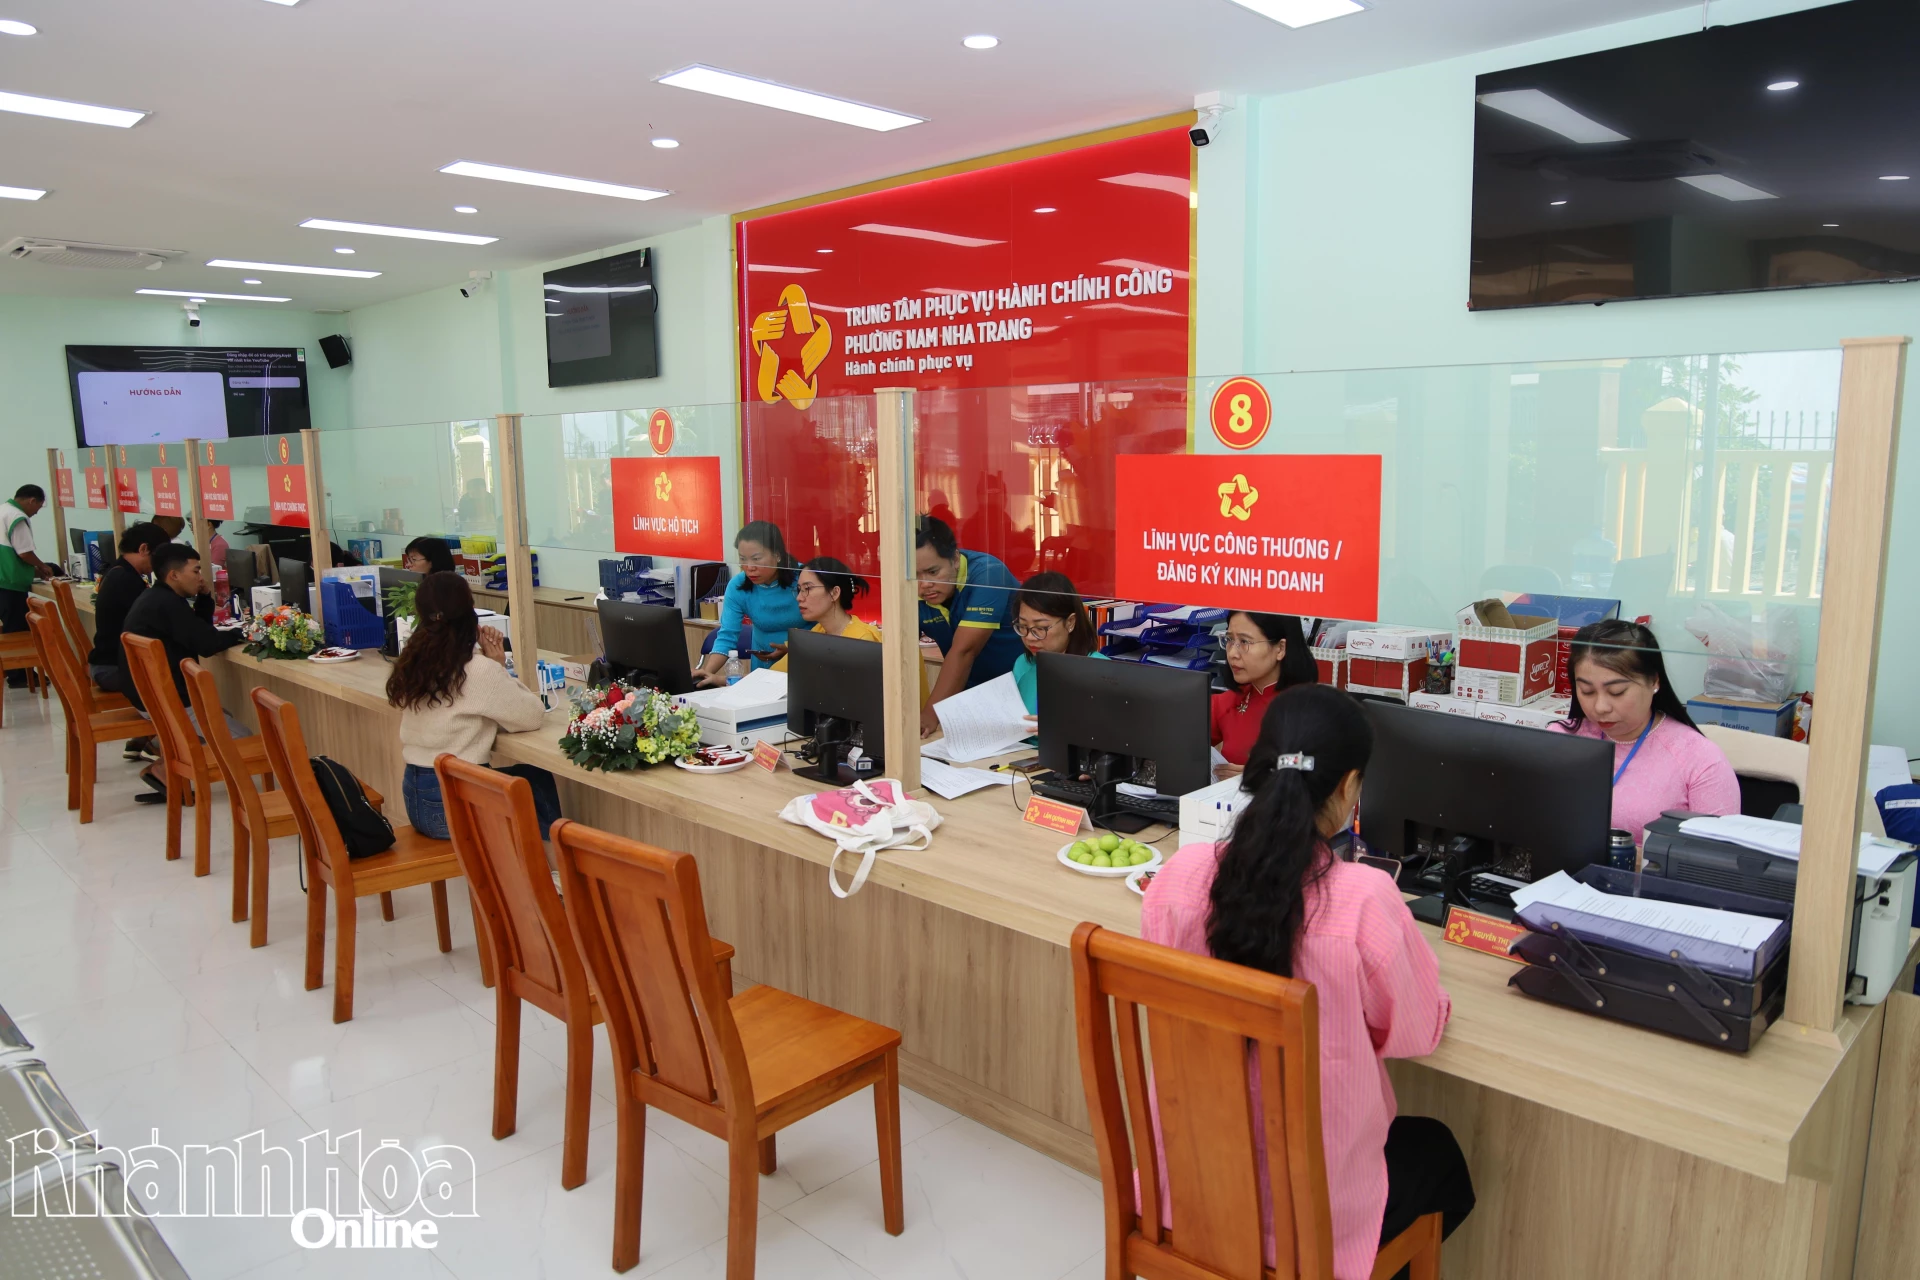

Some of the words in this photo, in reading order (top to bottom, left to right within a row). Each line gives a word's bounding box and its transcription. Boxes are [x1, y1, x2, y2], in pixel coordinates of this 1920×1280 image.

[845, 302, 891, 327] TRUNG
[893, 297, 922, 323] TÂM
[925, 294, 968, 321] PHỤC
[972, 291, 995, 316] VỤ
[998, 283, 1047, 310] HÀNH
[1051, 273, 1110, 305] CHÍNH
[1115, 267, 1173, 298] CÔNG
[845, 329, 904, 355] PHƯỜNG
[906, 328, 939, 350] NAM
[942, 324, 976, 346] NHA
[977, 317, 1033, 343] TRANG
[845, 360, 876, 376] Hành
[879, 355, 916, 374] chính
[918, 355, 952, 374] phục
[955, 354, 973, 372] vụ
[130, 388, 162, 396] HƯỚNG
[164, 386, 182, 396] DẪN
[1228, 394, 1252, 434] 8
[656, 420, 666, 444] 7
[209, 446, 213, 460] 5
[282, 442, 286, 458] 6
[633, 514, 650, 530] LĨNH
[652, 516, 666, 534] VỰC
[668, 516, 679, 536] HỘ
[680, 518, 698, 536] TỊCH
[1143, 528, 1176, 550] LĨNH
[1180, 532, 1210, 556] VỰC
[1214, 532, 1257, 556] CÔNG
[1261, 536, 1330, 560] THƯƠNG
[1334, 540, 1342, 560] /
[1157, 560, 1197, 583] ĐĂNG
[1201, 562, 1221, 584] KÝ
[1224, 568, 1262, 588] KINH
[1266, 570, 1324, 593] DOANH
[1531, 660, 1550, 676] Supreme
[1415, 702, 1439, 711] Supreme
[1480, 712, 1505, 722] Supreme
[1472, 930, 1497, 942] NGUYỄN
[1498, 936, 1508, 946] THỊ
